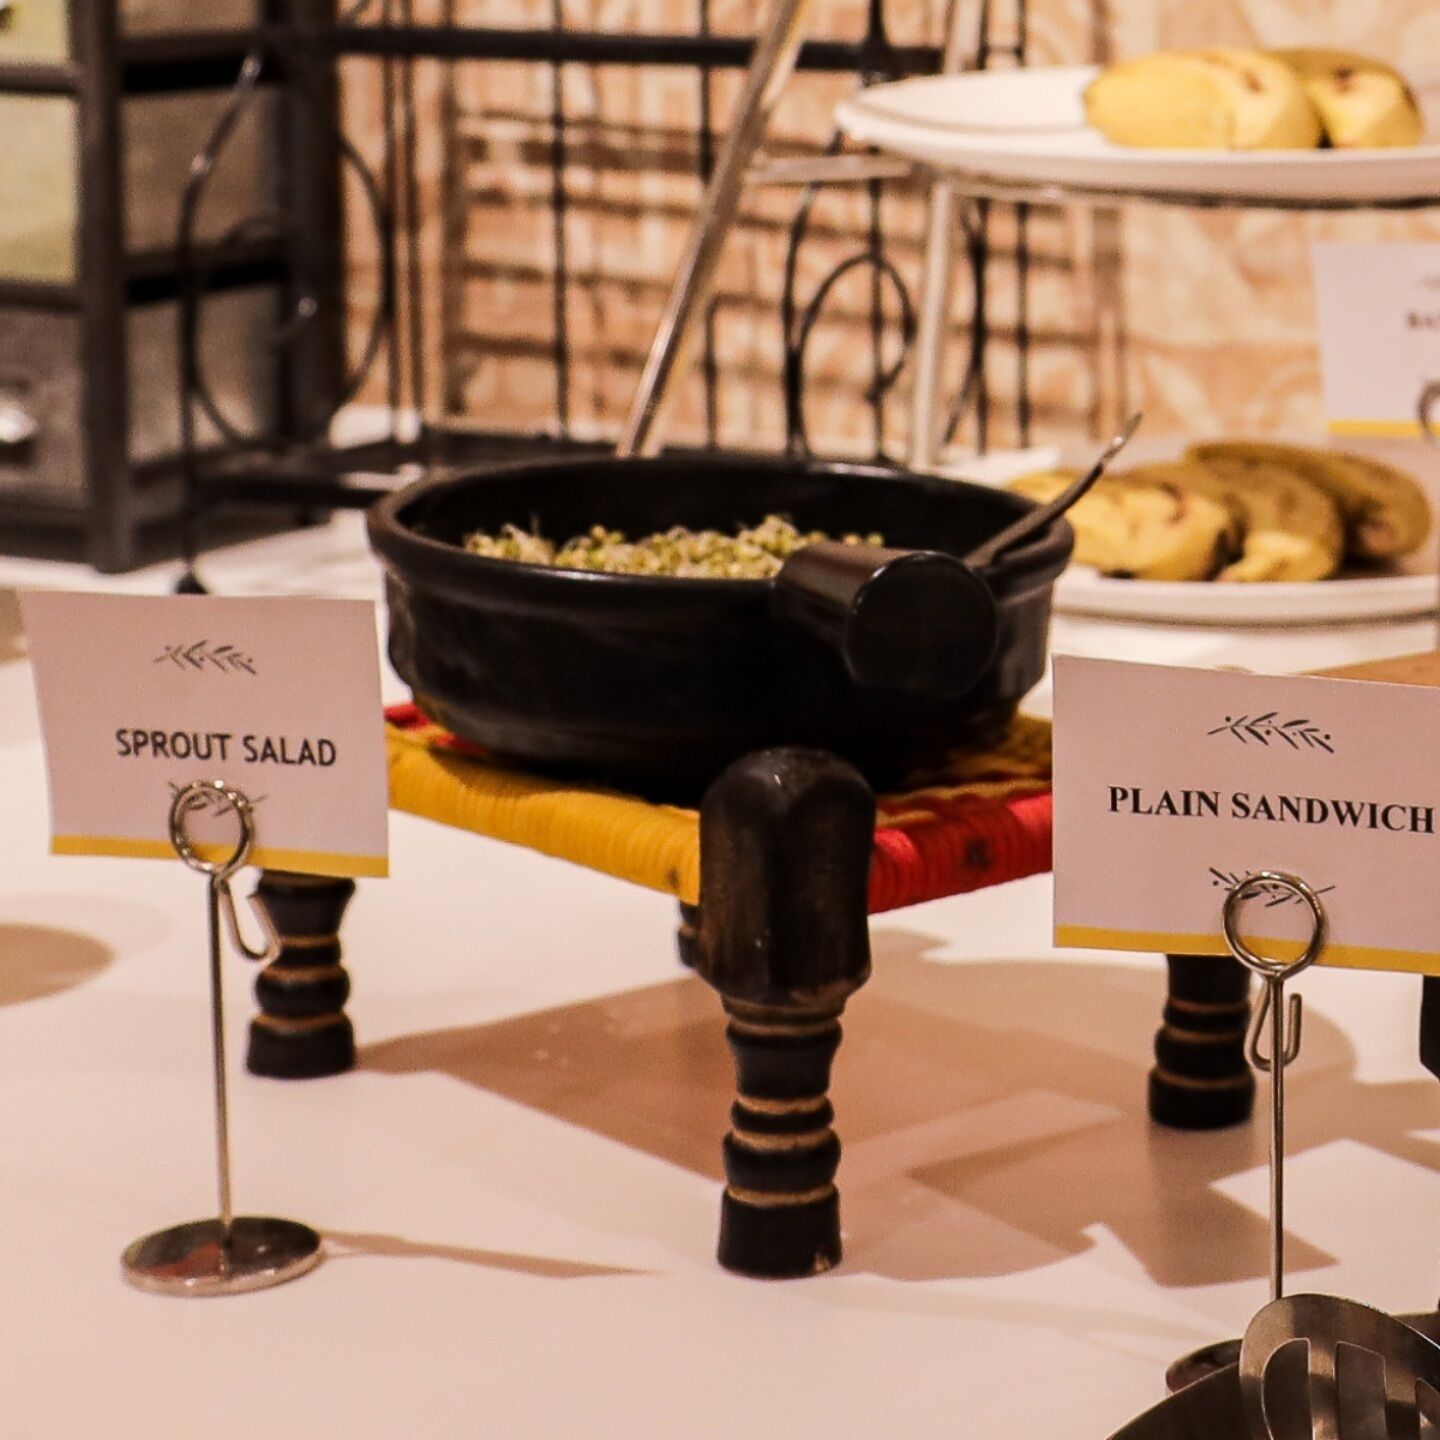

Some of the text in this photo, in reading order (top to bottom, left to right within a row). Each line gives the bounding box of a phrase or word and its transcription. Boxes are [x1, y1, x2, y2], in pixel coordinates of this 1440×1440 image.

[115, 728, 337, 767] SPROUT SALAD
[1108, 786, 1435, 835] PLAIN SANDWICH
